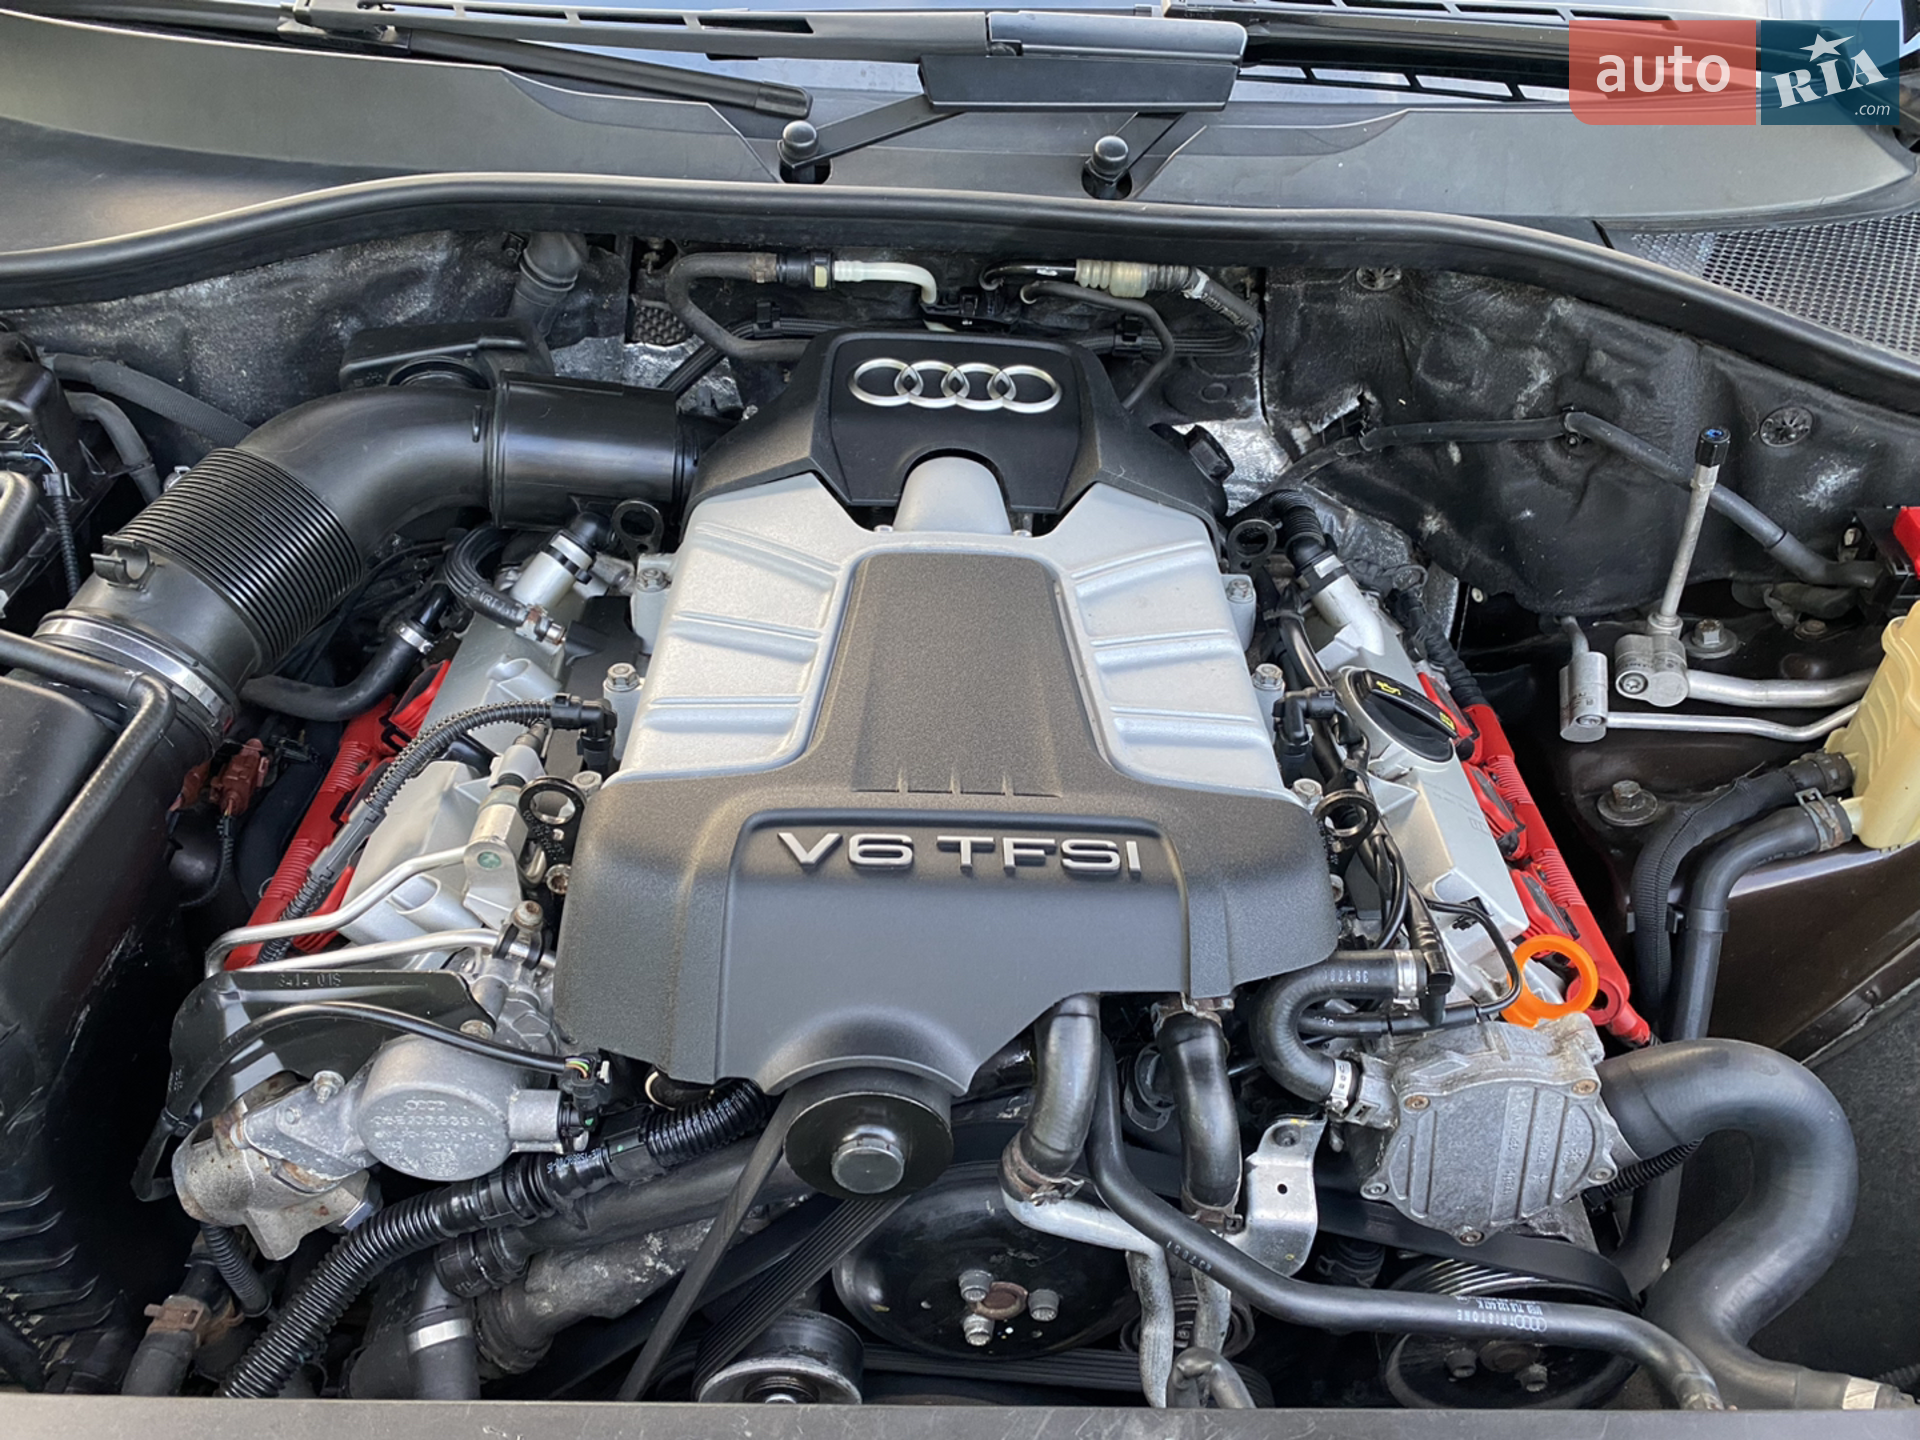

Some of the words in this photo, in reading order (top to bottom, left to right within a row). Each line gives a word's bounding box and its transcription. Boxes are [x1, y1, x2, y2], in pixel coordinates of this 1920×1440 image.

[777, 832, 914, 871] V6
[936, 835, 1142, 877] TFSI
[1456, 1309, 1515, 1327] TRISTONE
